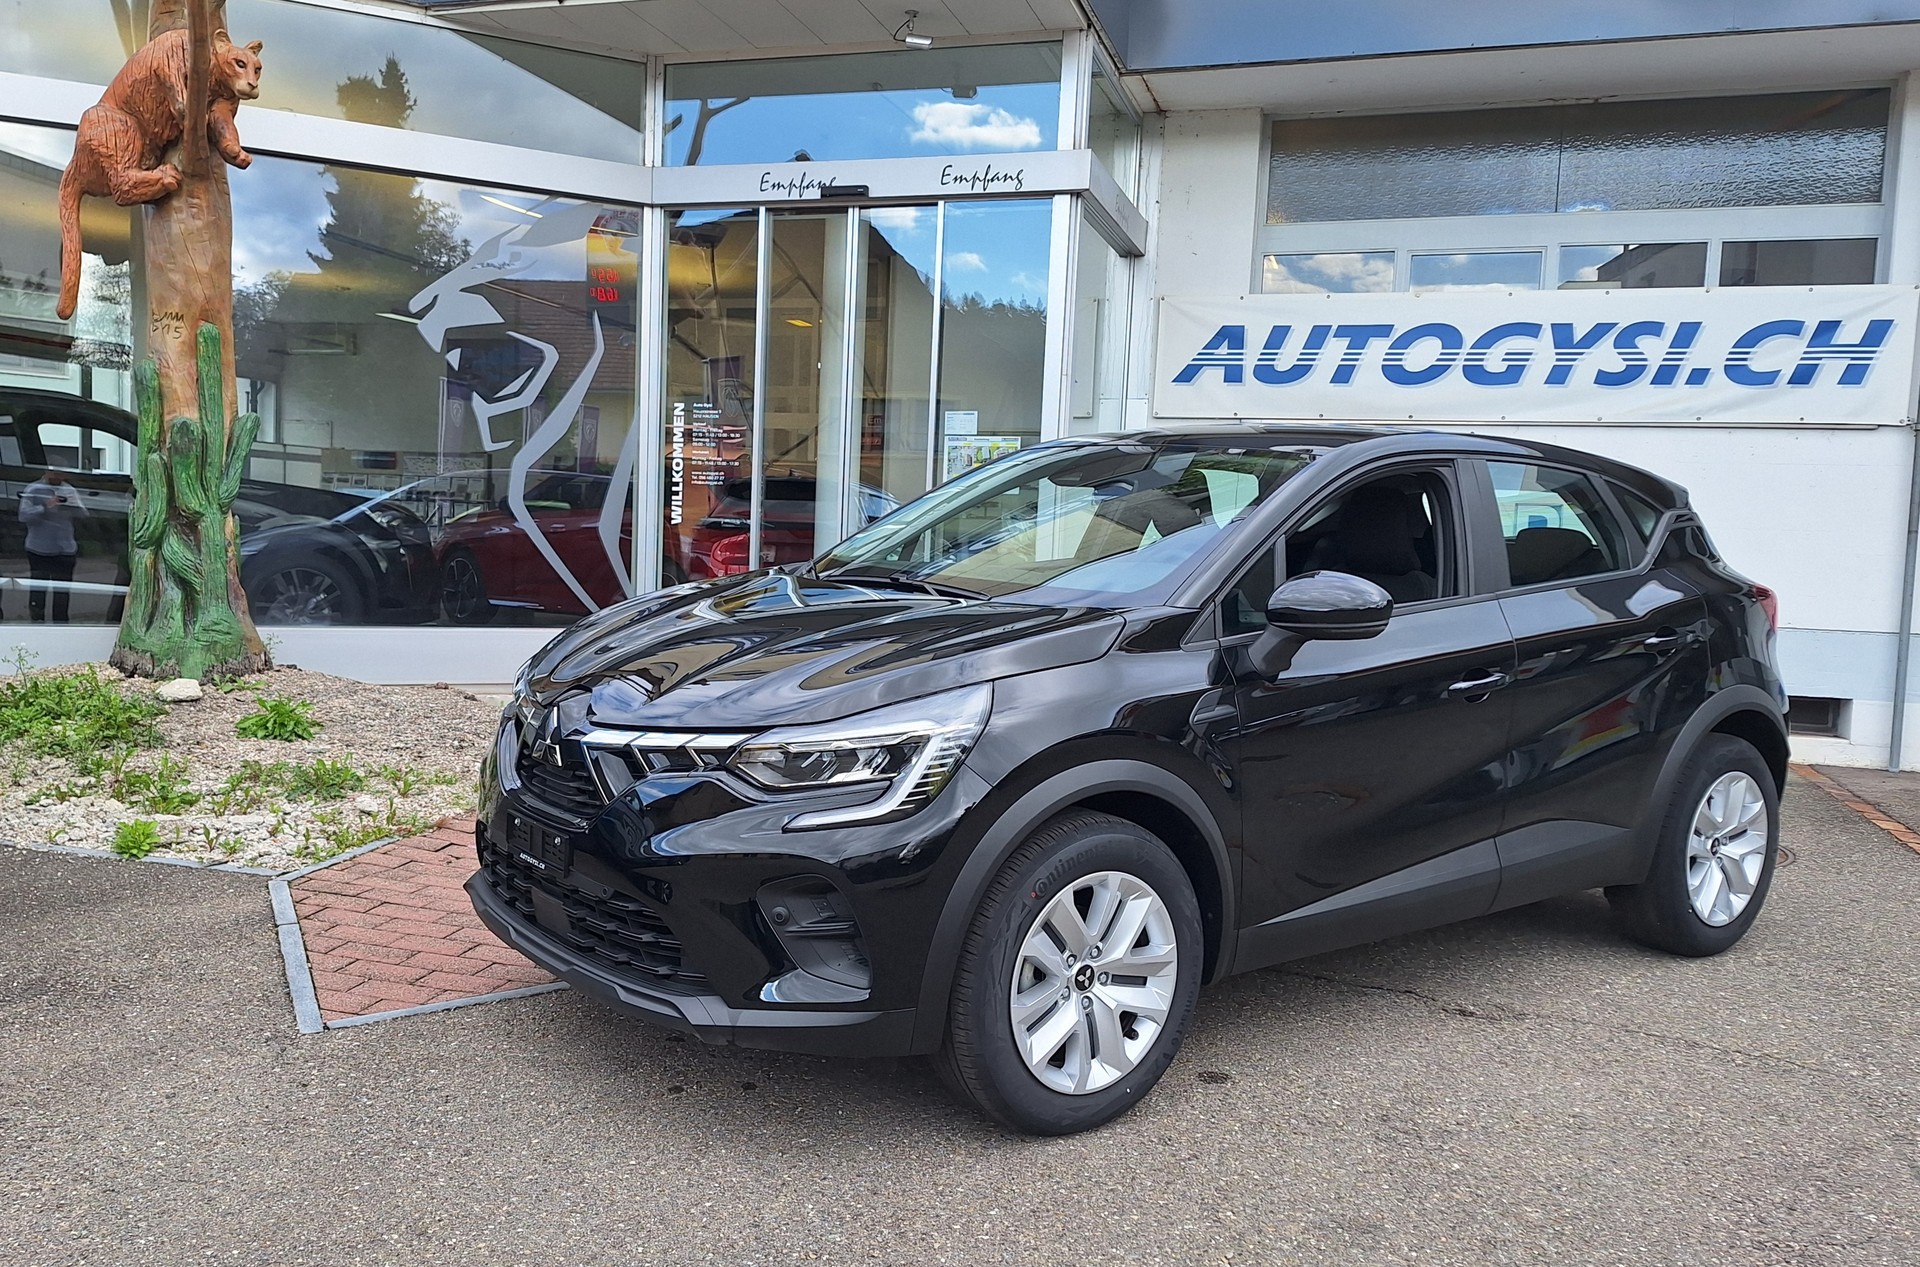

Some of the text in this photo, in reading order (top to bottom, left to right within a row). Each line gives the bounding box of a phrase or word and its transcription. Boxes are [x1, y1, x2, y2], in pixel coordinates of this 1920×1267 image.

[941, 163, 1024, 191] Empfang
[1171, 319, 1895, 387] AUTOGYSI.CH
[670, 402, 685, 525] WILLKOMMEN
